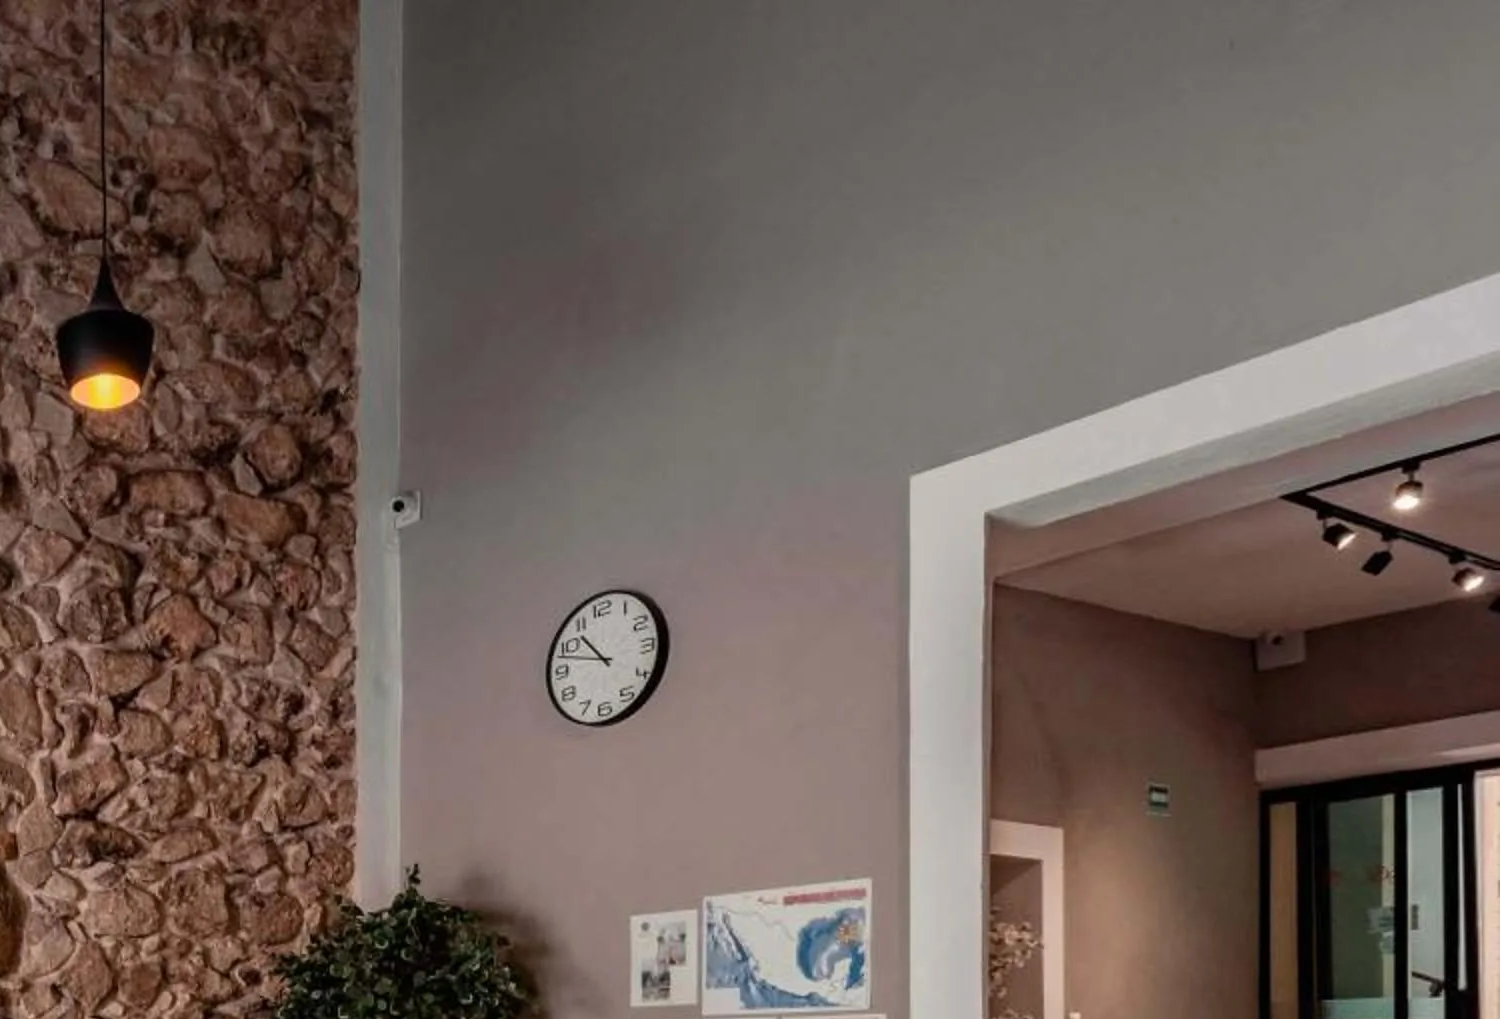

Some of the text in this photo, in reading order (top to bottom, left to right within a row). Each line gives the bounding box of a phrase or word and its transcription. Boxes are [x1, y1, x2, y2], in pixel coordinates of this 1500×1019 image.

[592, 599, 613, 619] 12
[622, 600, 628, 617] 1
[575, 616, 587, 632] 11
[632, 615, 649, 632] 2
[561, 637, 581, 656] 10
[640, 636, 655, 655] 3
[555, 664, 569, 681] 9
[635, 667, 651, 681] 4
[561, 686, 577, 702] 8
[619, 685, 636, 703] 5
[579, 699, 592, 717] 7
[597, 701, 613, 718] 6
